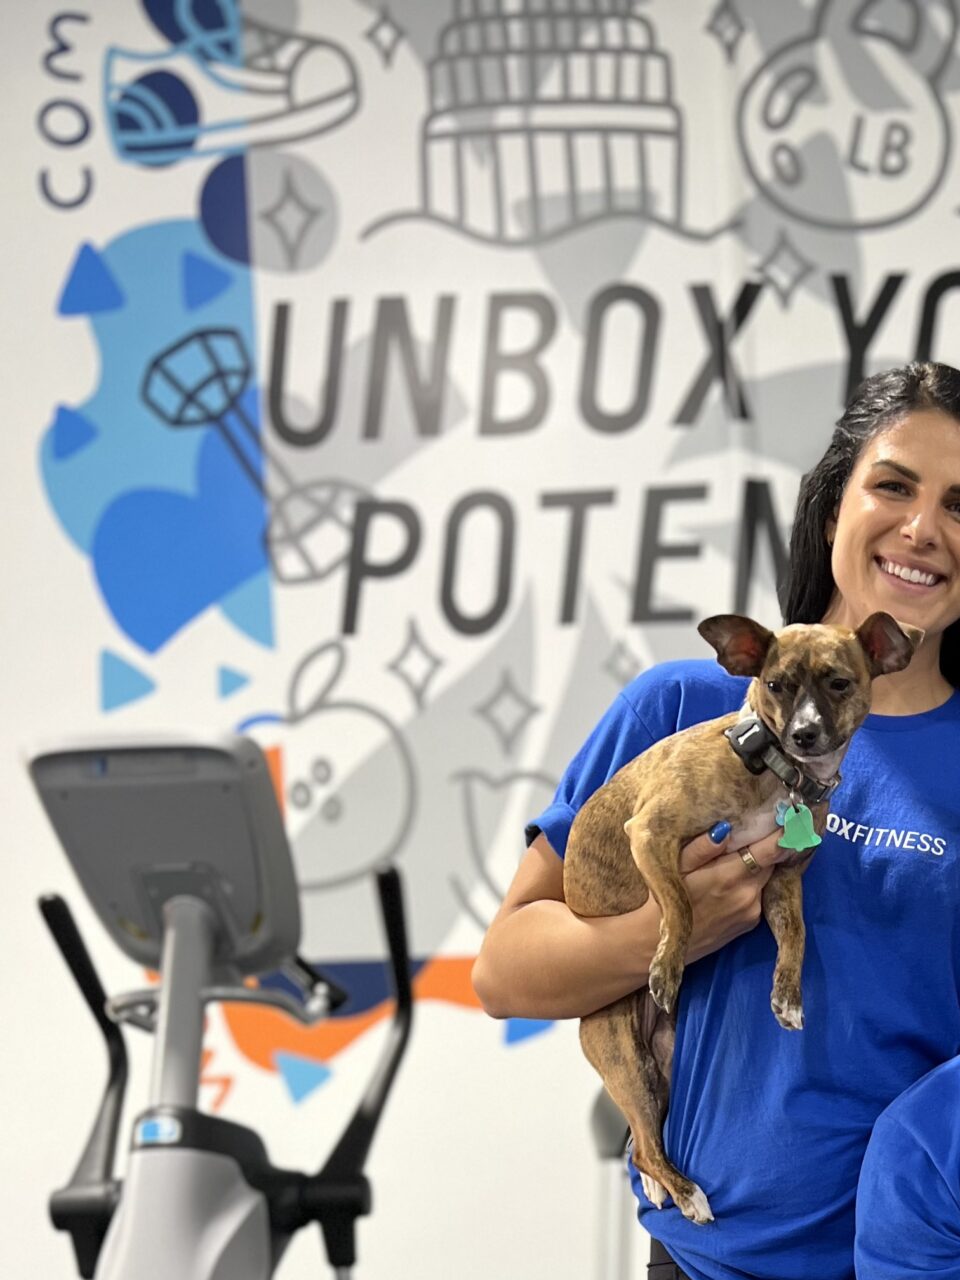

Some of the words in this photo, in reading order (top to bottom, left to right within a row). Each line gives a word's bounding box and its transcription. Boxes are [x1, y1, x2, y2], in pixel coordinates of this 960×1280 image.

[38, 12, 93, 210] COM
[847, 113, 911, 178] LB
[267, 282, 763, 449] UNBOX
[826, 813, 947, 856] OXFITNESS
